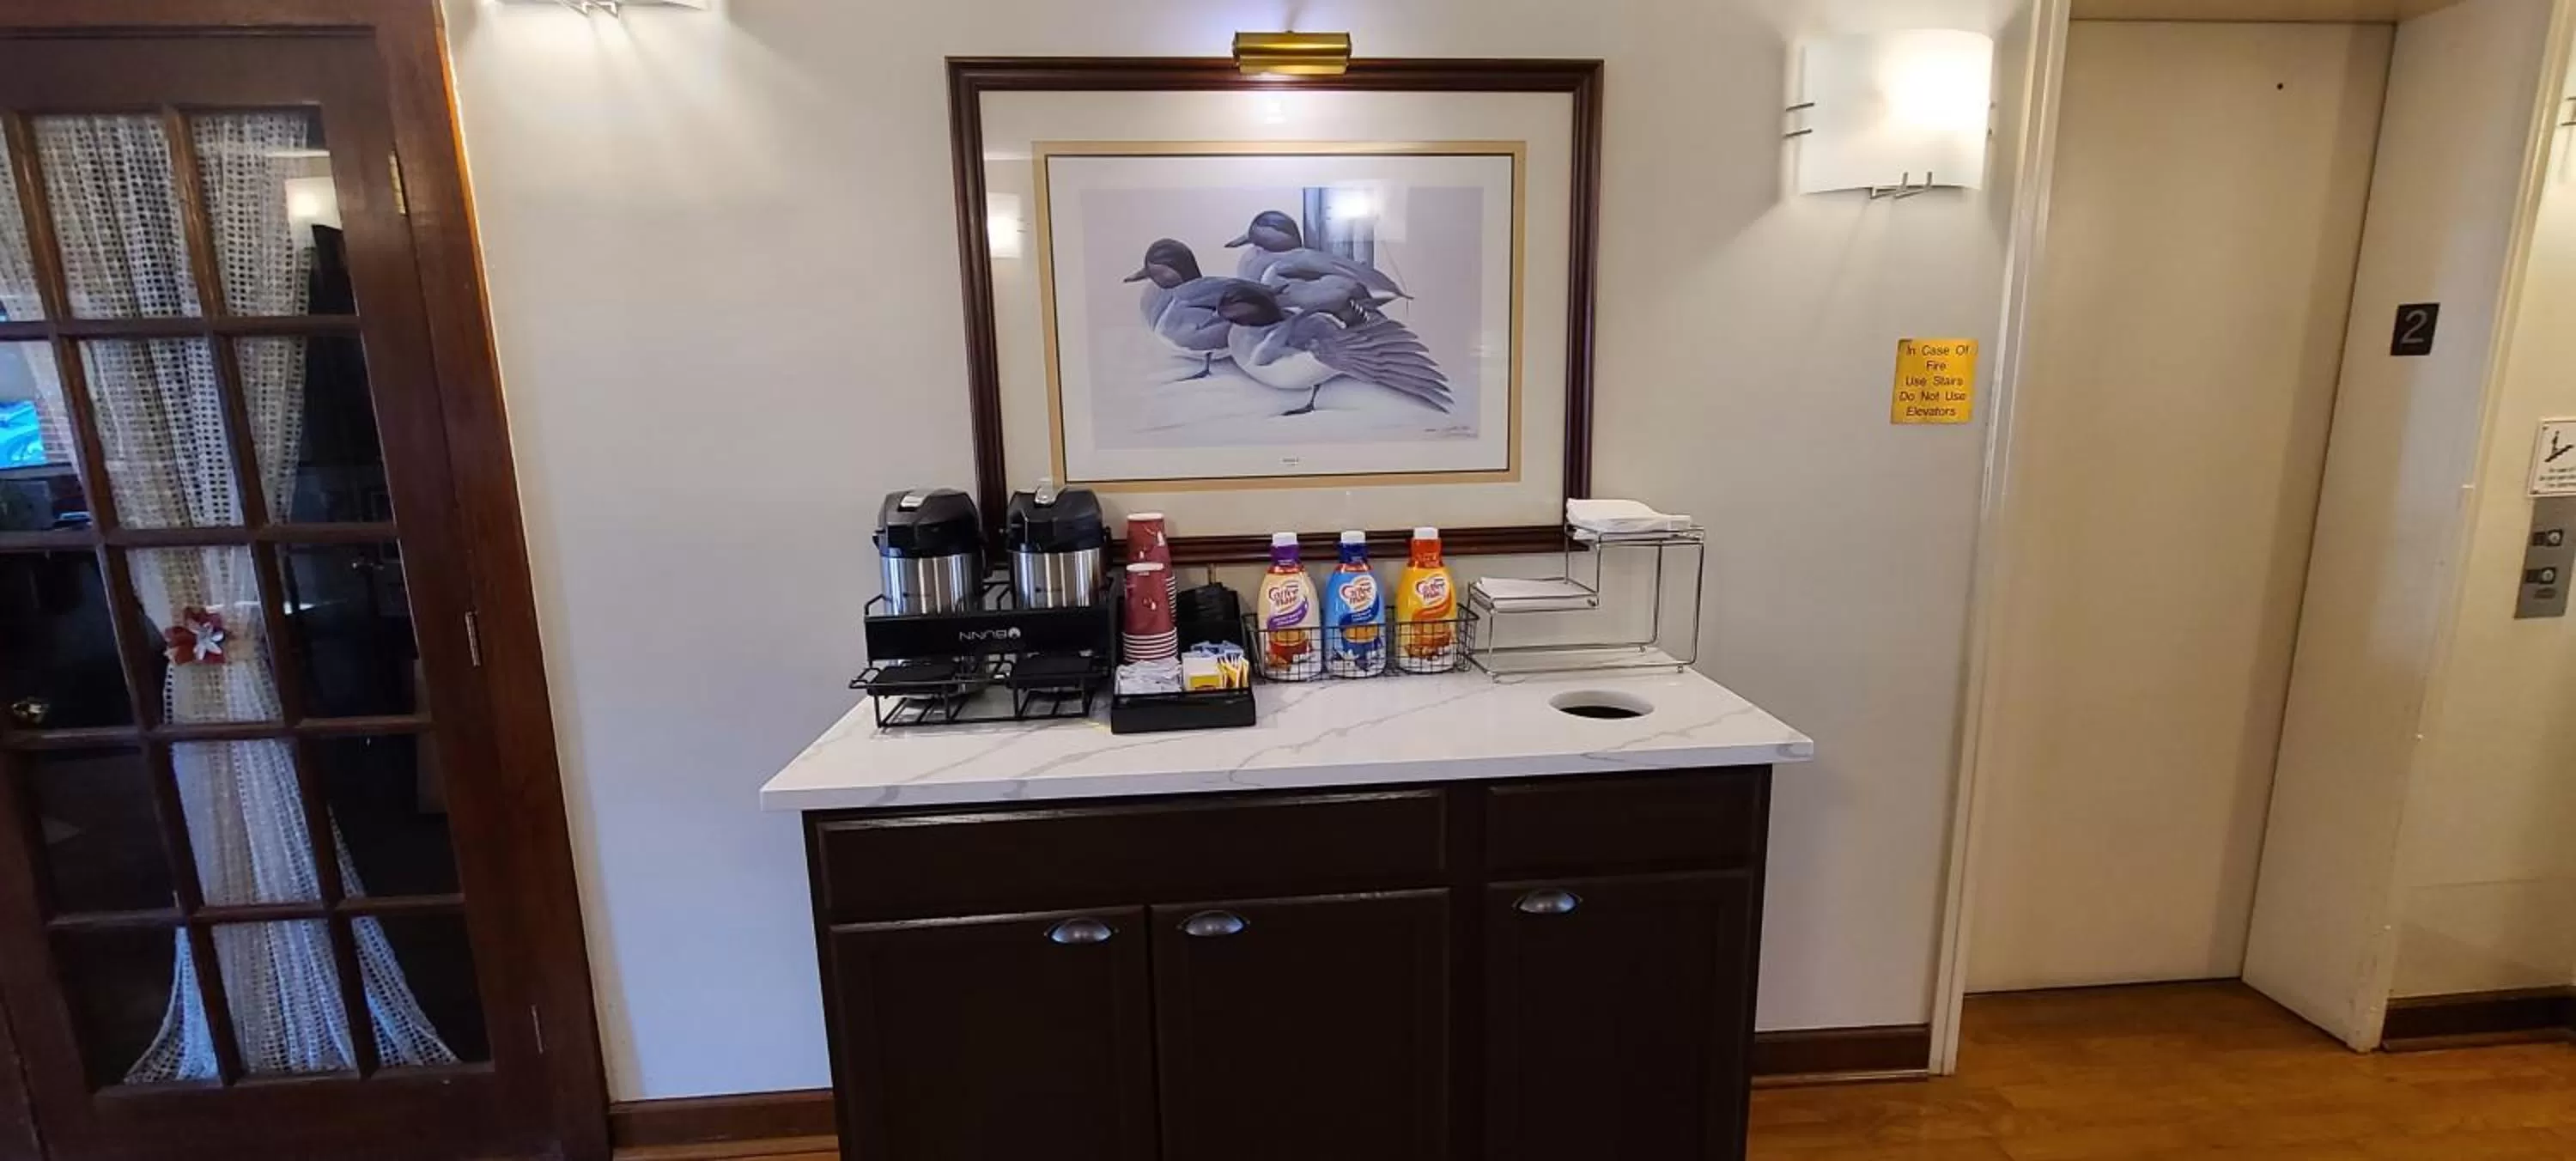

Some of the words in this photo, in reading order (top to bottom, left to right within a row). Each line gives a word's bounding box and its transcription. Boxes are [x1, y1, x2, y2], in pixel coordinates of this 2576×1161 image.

[2401, 310, 2427, 343] 2
[1906, 344, 1916, 356] In
[1922, 344, 1950, 356] Case
[1956, 344, 1969, 356] Of
[1926, 361, 1947, 371] Fire
[1905, 376, 1927, 386] Use
[1933, 375, 1964, 386] Stairs
[1899, 391, 1916, 401] Do
[1921, 391, 1940, 401] Not
[1945, 391, 1965, 401] Use
[1905, 406, 1956, 416] Elevators
[958, 629, 1007, 641] BUNN
